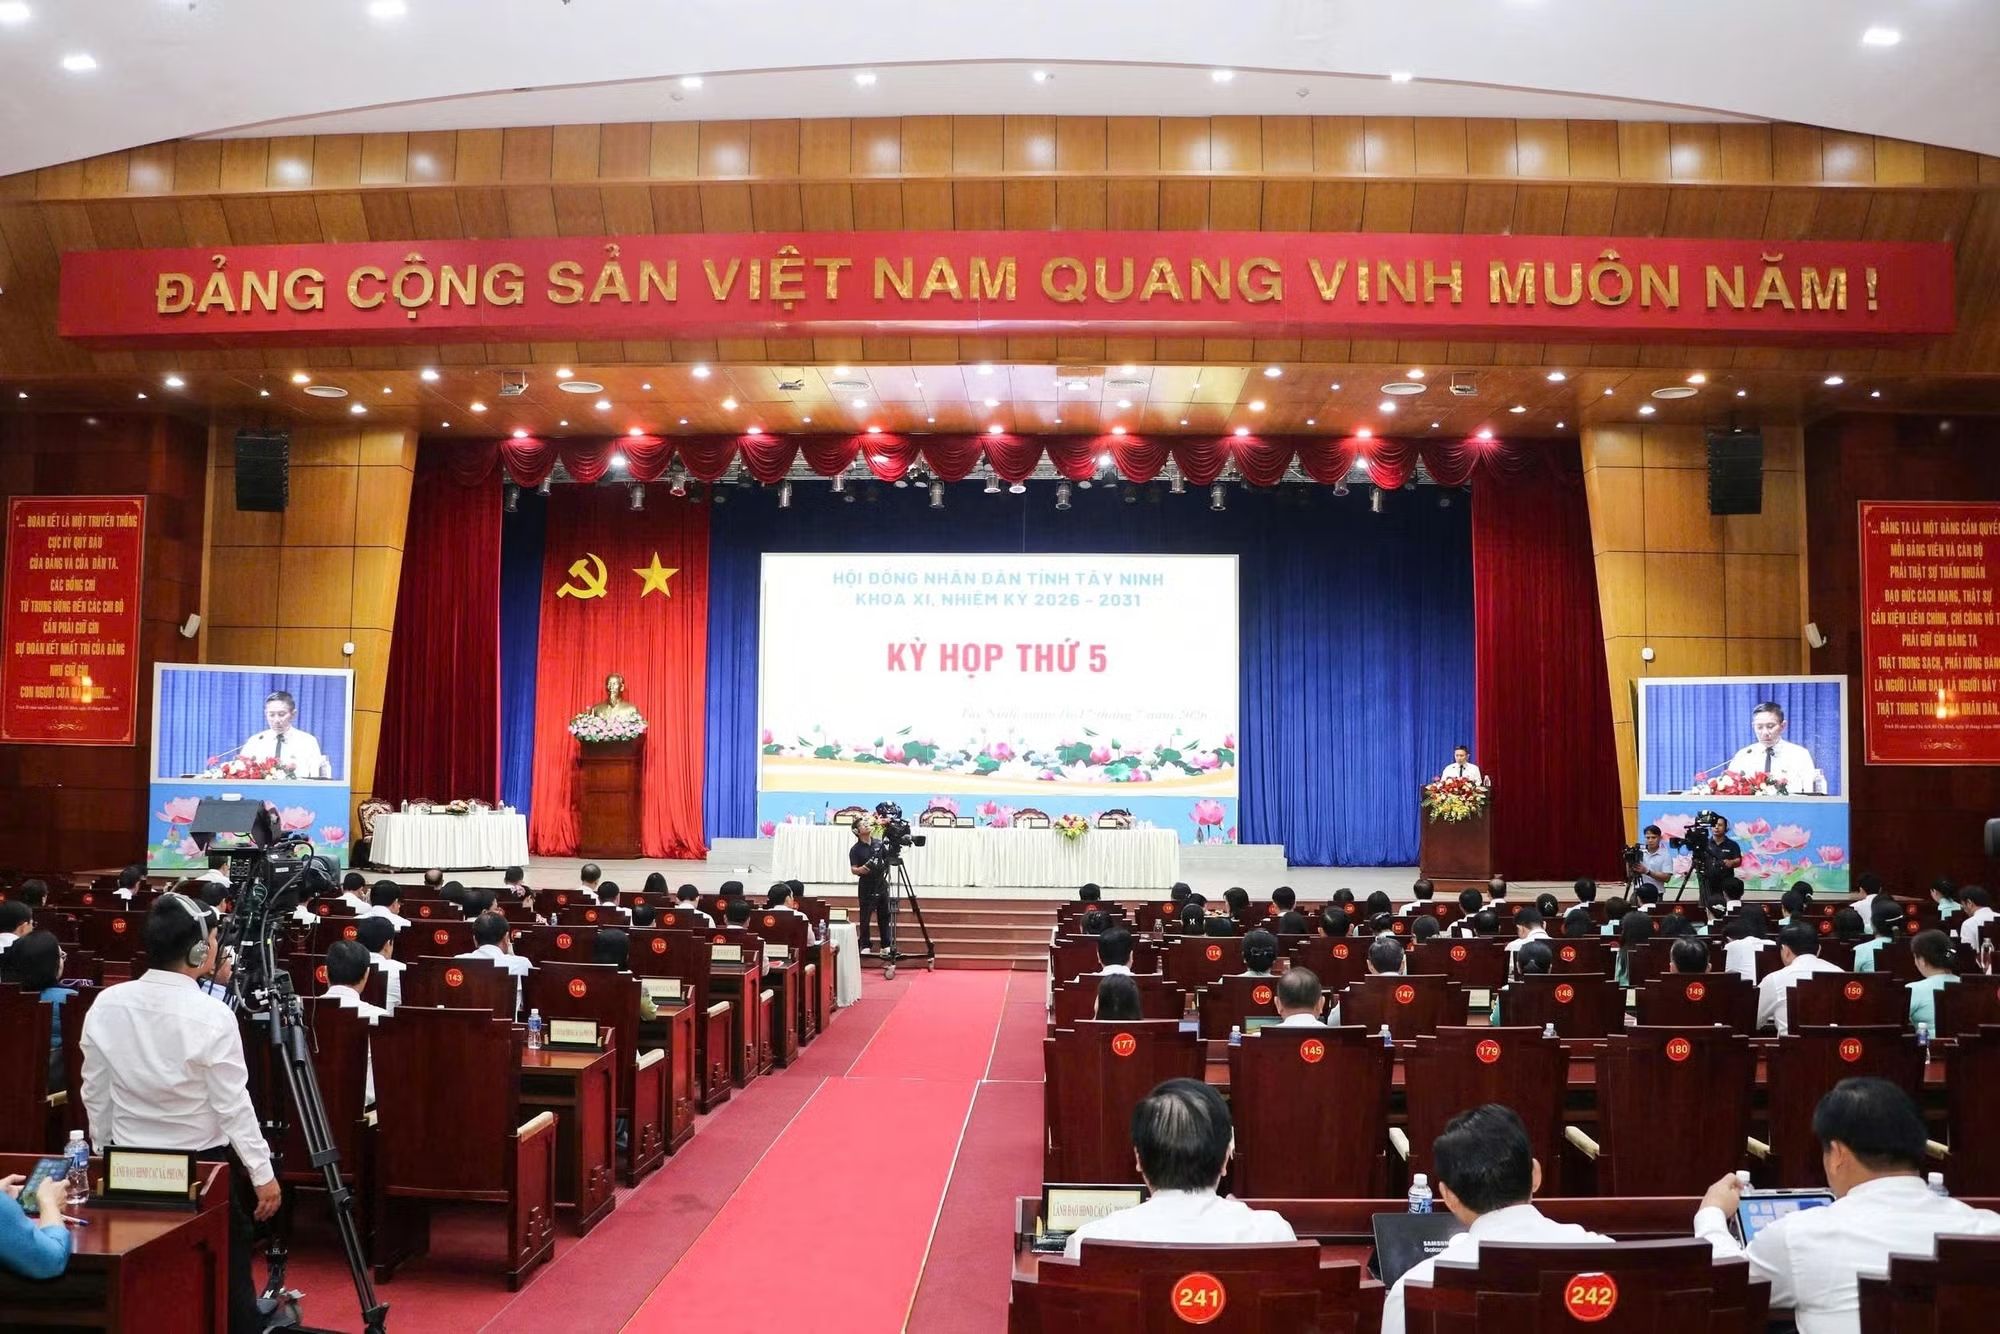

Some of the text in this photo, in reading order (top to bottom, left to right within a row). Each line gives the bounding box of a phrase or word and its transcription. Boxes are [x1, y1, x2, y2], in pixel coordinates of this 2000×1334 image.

[155, 243, 1879, 319] ĐẢNG CỘNG SẢN VIỆT NAM QUANG VINH MUÔN NĂM !
[1901, 521, 1910, 534] TA
[1912, 519, 1920, 534] LÀ
[833, 570, 862, 587] HỘI
[869, 569, 918, 585] ĐỒNG
[925, 569, 976, 585] NHÂN
[982, 569, 1021, 585] DÂN
[1075, 570, 1113, 586] TÂY
[1120, 573, 1164, 586] NINH
[856, 591, 1141, 608] KHOA XI, NHIỆM KỲ 2026 2031
[1968, 634, 1978, 646] TA
[887, 635, 1108, 678] KỲ HỌP THỨ 5
[1115, 1040, 1134, 1049] 177
[1303, 1046, 1321, 1055] 145
[1480, 1047, 1498, 1056] 179
[1670, 1045, 1687, 1054] 180
[1843, 1045, 1860, 1054] 181
[1179, 1289, 1218, 1308] 241
[1571, 1286, 1612, 1305] 242
